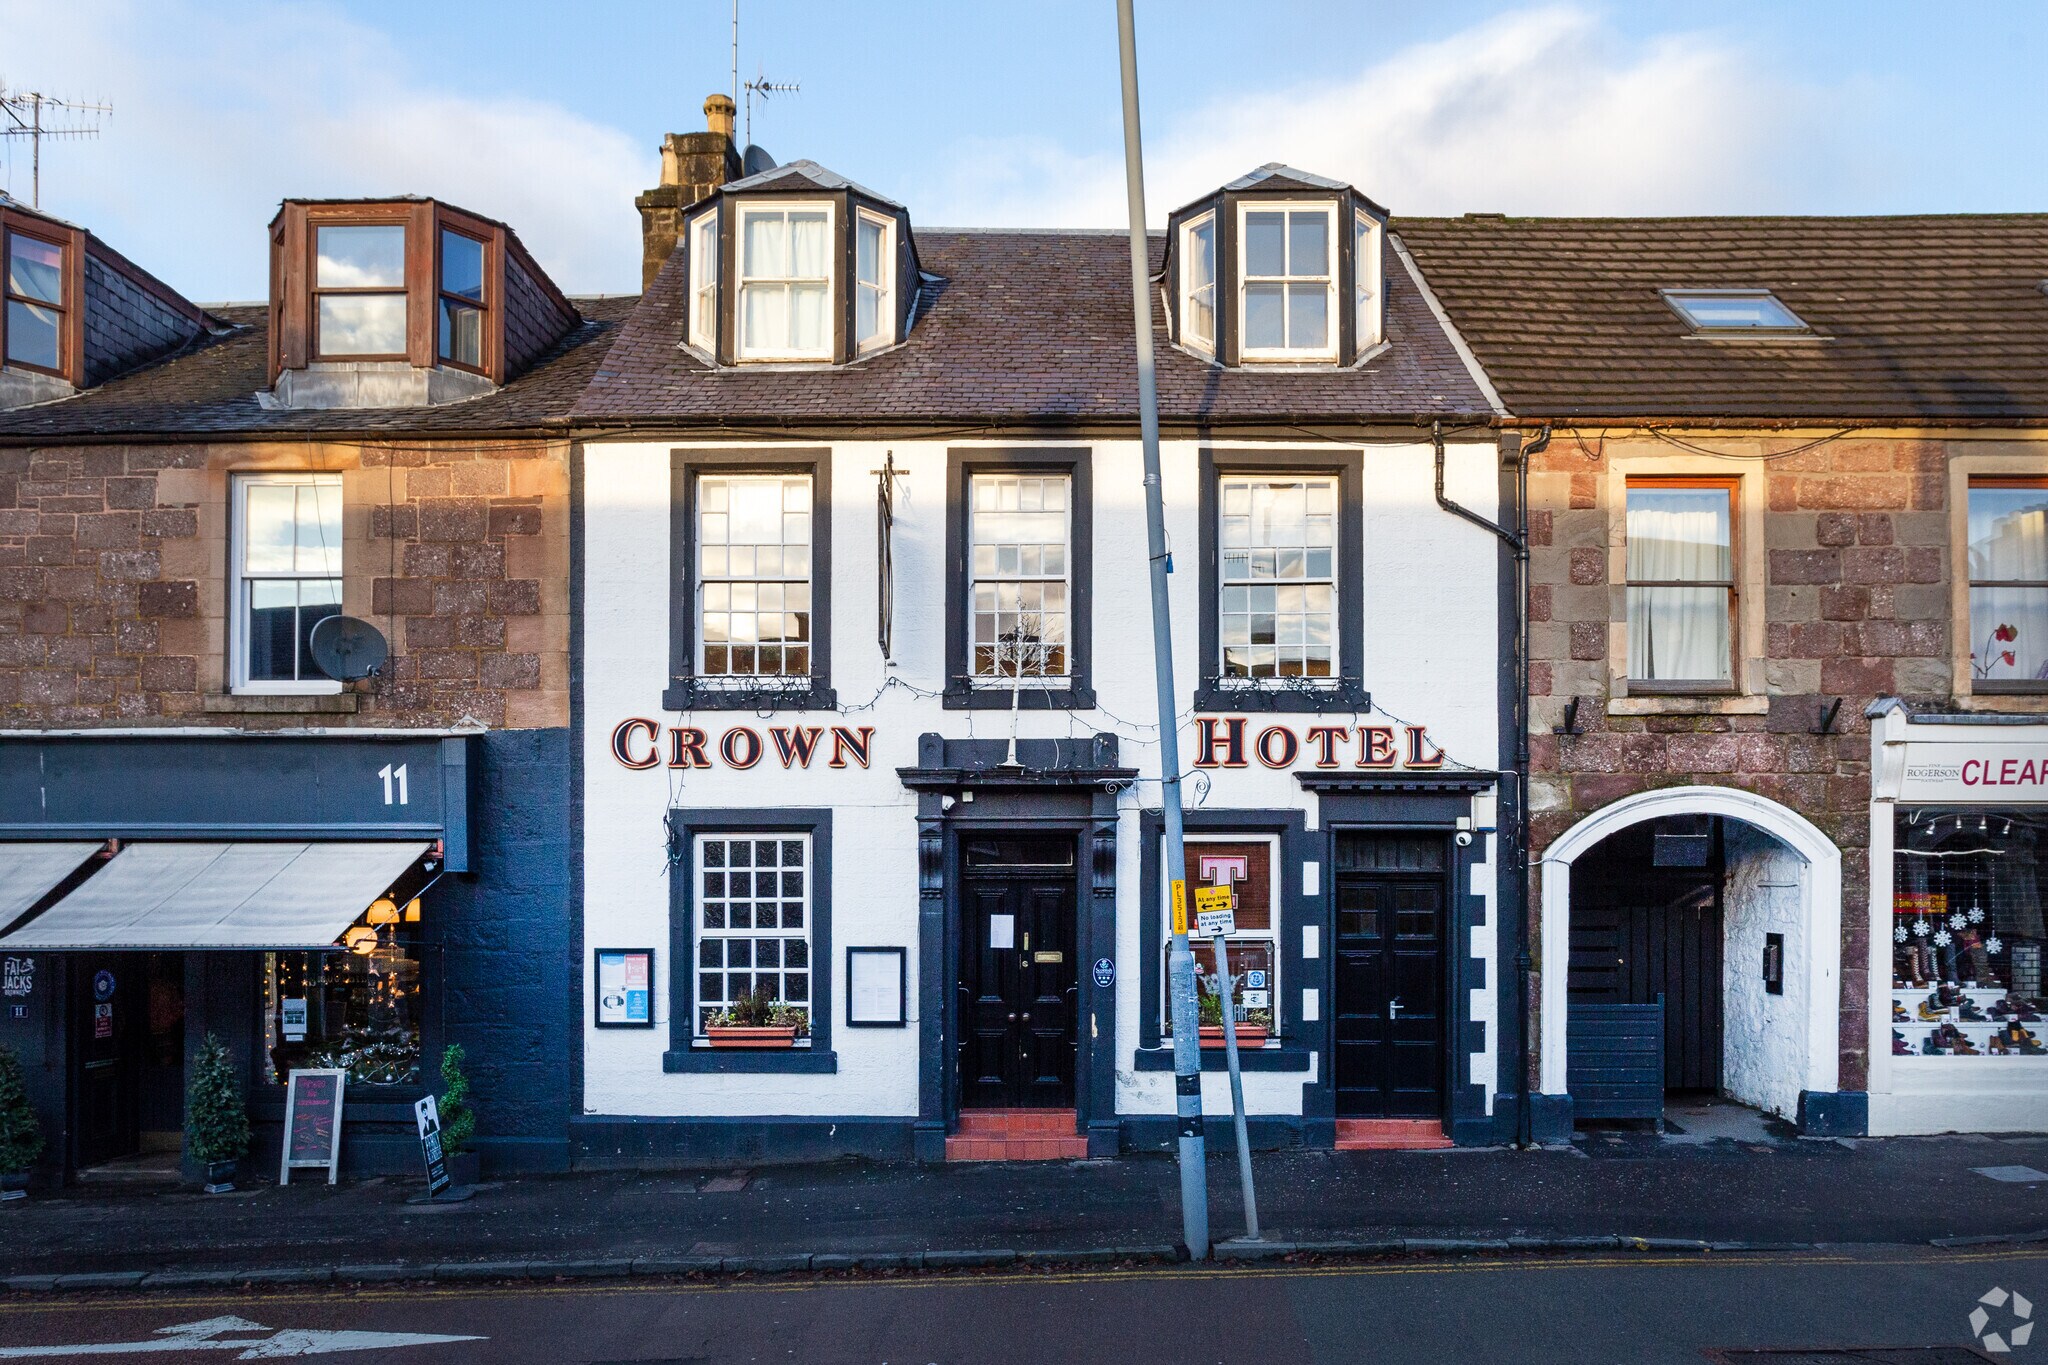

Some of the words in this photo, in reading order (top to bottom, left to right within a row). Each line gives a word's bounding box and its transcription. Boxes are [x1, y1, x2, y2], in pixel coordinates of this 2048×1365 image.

[610, 717, 875, 770] CROWN
[1192, 717, 1446, 769] HOTEL
[1907, 768, 1960, 778] ROGERSON
[378, 763, 408, 805] 11
[4, 957, 22, 976] FAT
[2, 975, 32, 993] JACKS
